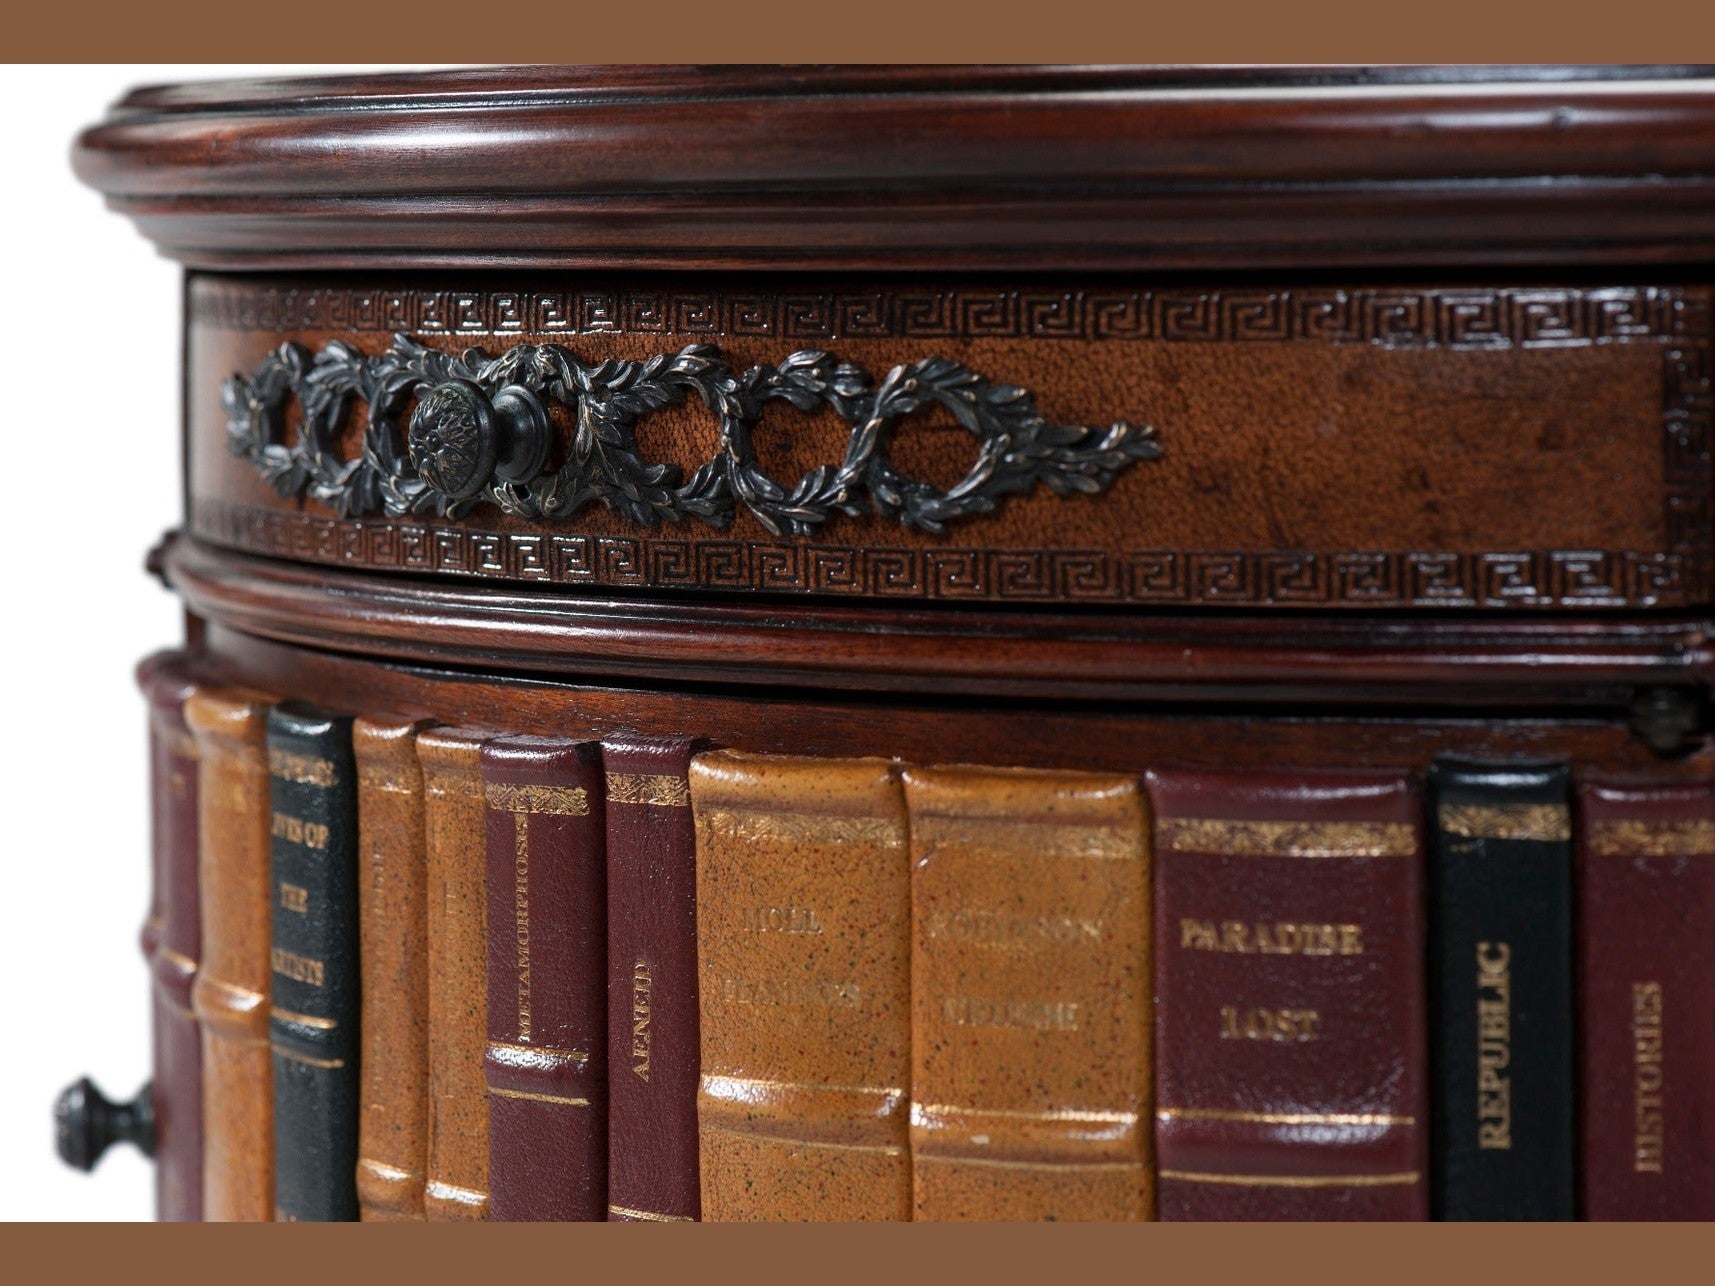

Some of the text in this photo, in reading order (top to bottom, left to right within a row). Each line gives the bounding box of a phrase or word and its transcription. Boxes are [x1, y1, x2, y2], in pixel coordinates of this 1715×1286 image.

[1178, 917, 1365, 956] PARADISE
[632, 958, 652, 1083] AENEID
[1218, 1005, 1321, 1042] LOST
[1475, 940, 1512, 1151] REPUBLIC
[1631, 981, 1664, 1174] HISTORIES
